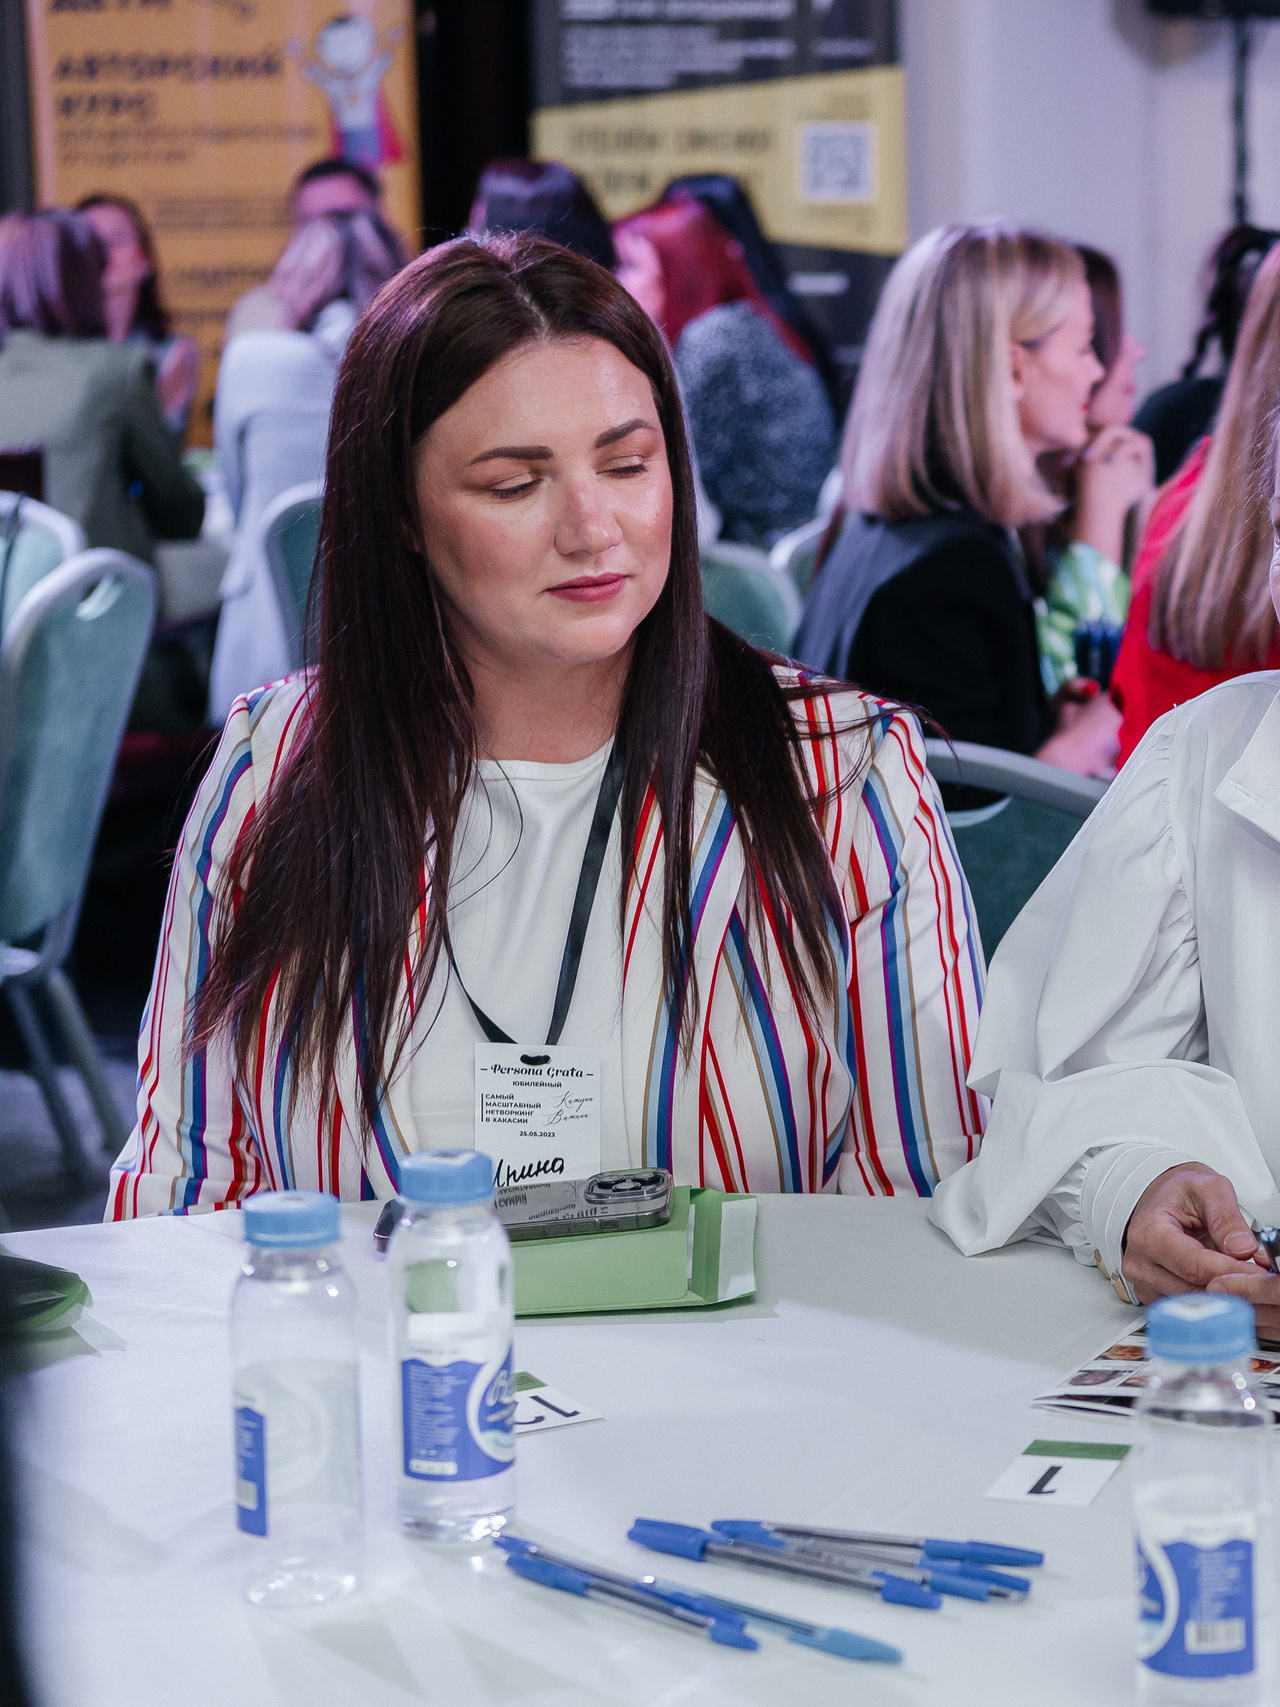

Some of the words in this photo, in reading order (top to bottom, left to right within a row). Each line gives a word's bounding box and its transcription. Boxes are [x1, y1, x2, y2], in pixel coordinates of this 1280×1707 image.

[490, 1064, 543, 1076] Persona
[546, 1067, 583, 1078] Grata
[512, 1080, 563, 1088] ЮБИЛЕЙНЫЙ
[485, 1101, 542, 1109] МАСШТАБНЫЙ
[1027, 1465, 1062, 1495] 1
